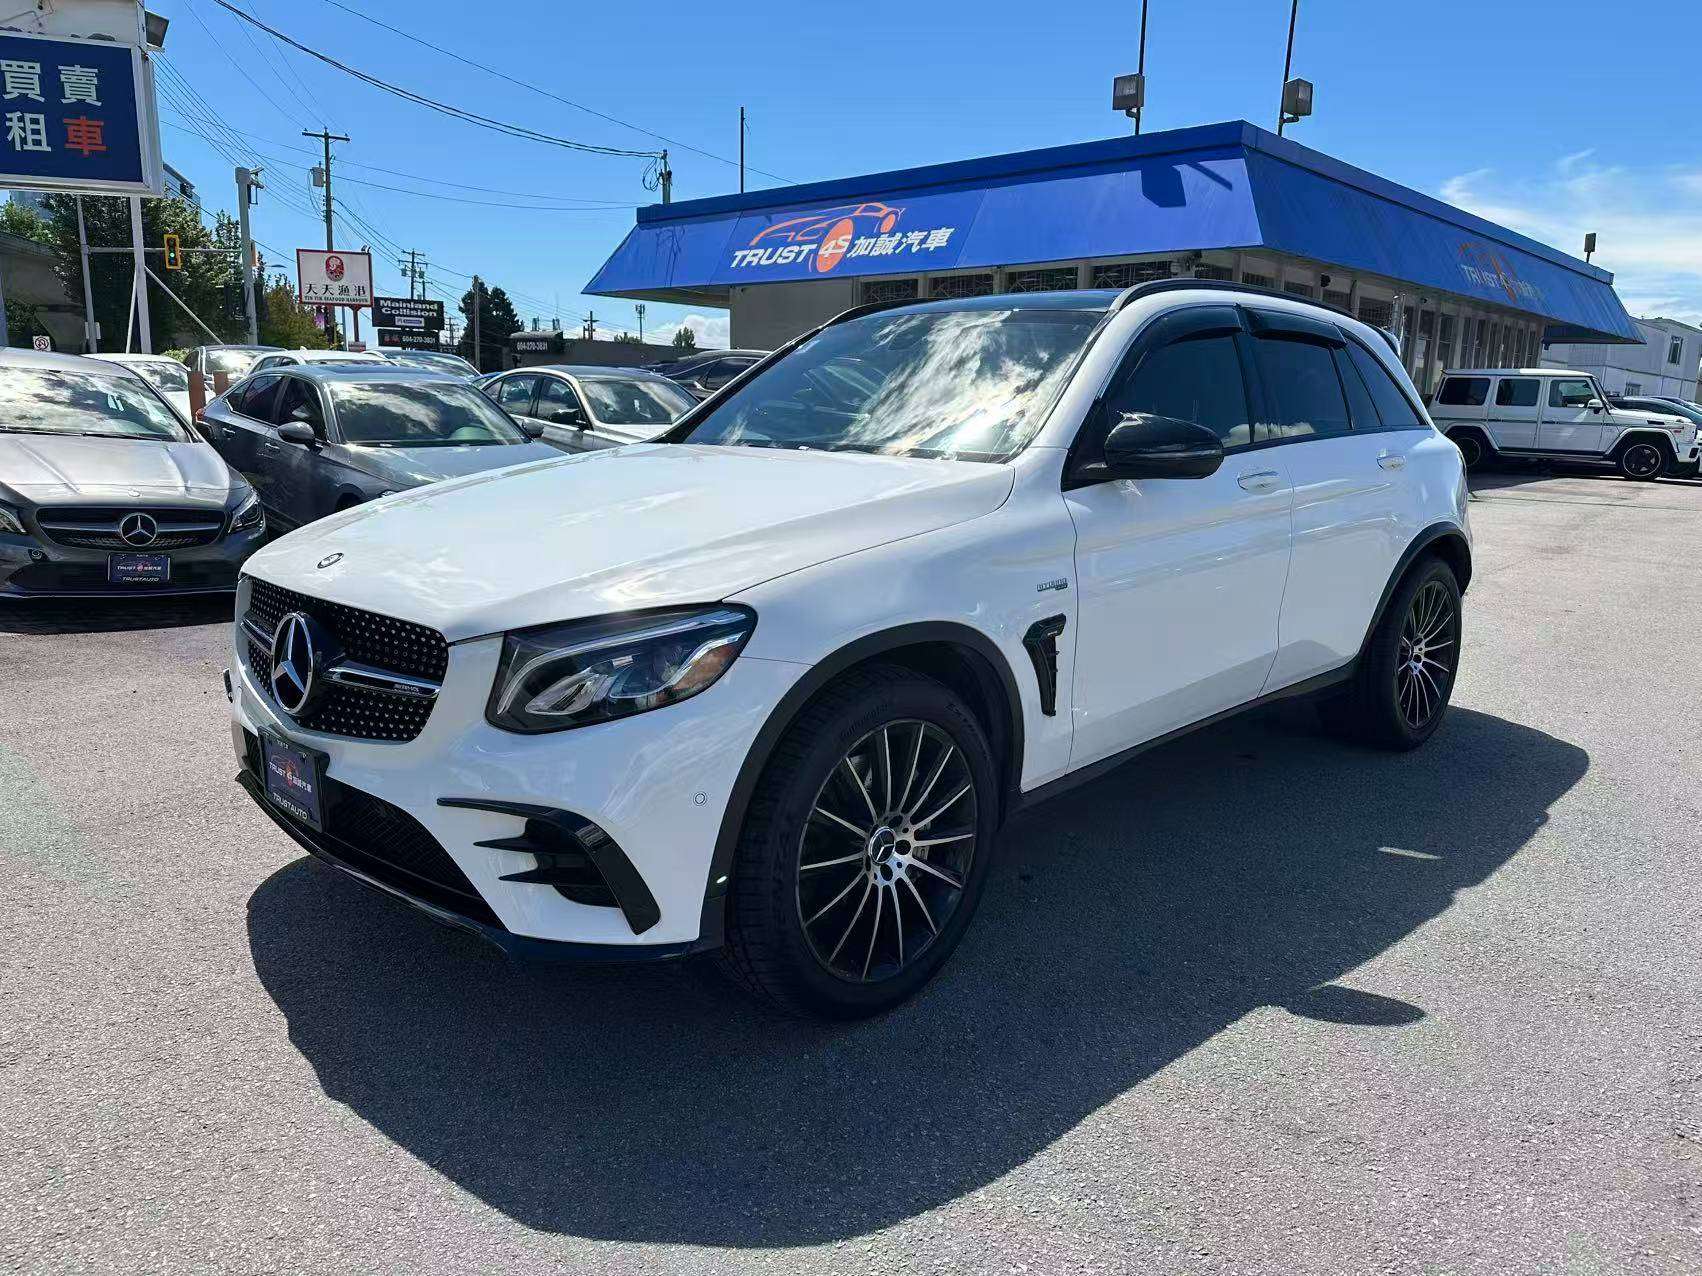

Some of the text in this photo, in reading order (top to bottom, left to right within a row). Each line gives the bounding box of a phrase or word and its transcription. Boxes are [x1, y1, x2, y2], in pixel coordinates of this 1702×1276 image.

[729, 243, 818, 268] TRUST
[847, 227, 954, 259] 加誠汽車
[379, 300, 438, 310] Mainland
[381, 307, 437, 317] Collision
[269, 761, 286, 776] TRUST
[273, 792, 308, 820] TRUSTAUTO
